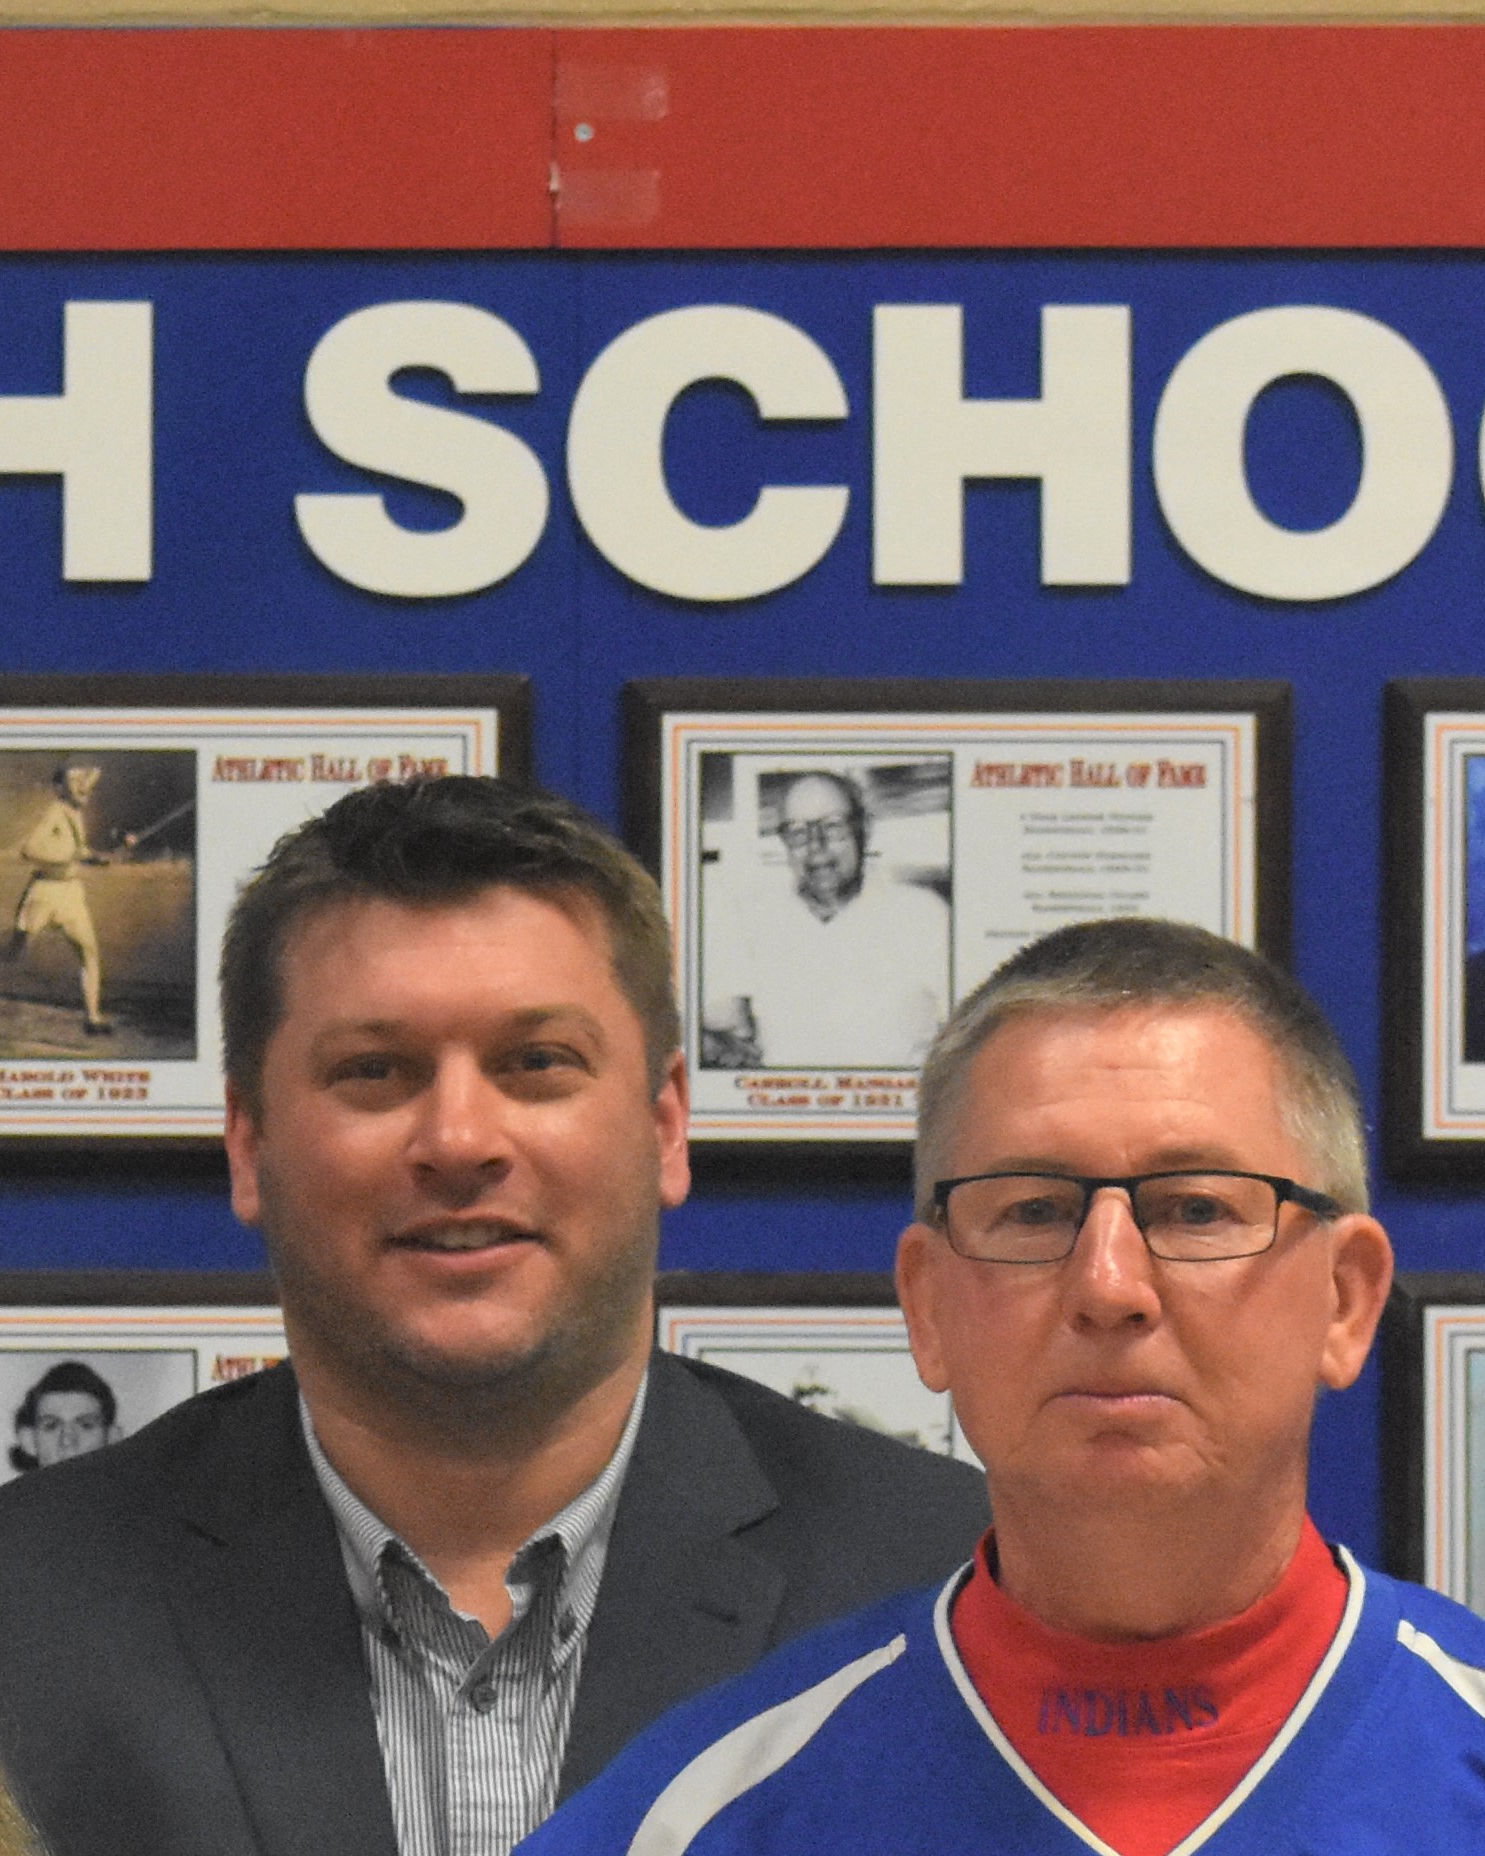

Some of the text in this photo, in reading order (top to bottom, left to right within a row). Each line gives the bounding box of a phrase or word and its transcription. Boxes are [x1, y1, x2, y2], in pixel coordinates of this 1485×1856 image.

[211, 755, 304, 782] ATHLETIC
[311, 755, 361, 782] HALL
[1070, 759, 1120, 788] HALL
[1126, 763, 1151, 788] OF
[1157, 759, 1206, 788] FAME
[62, 1088, 87, 1100] OF
[817, 1094, 843, 1106] OF
[1036, 1685, 1220, 1738] INDIANS
